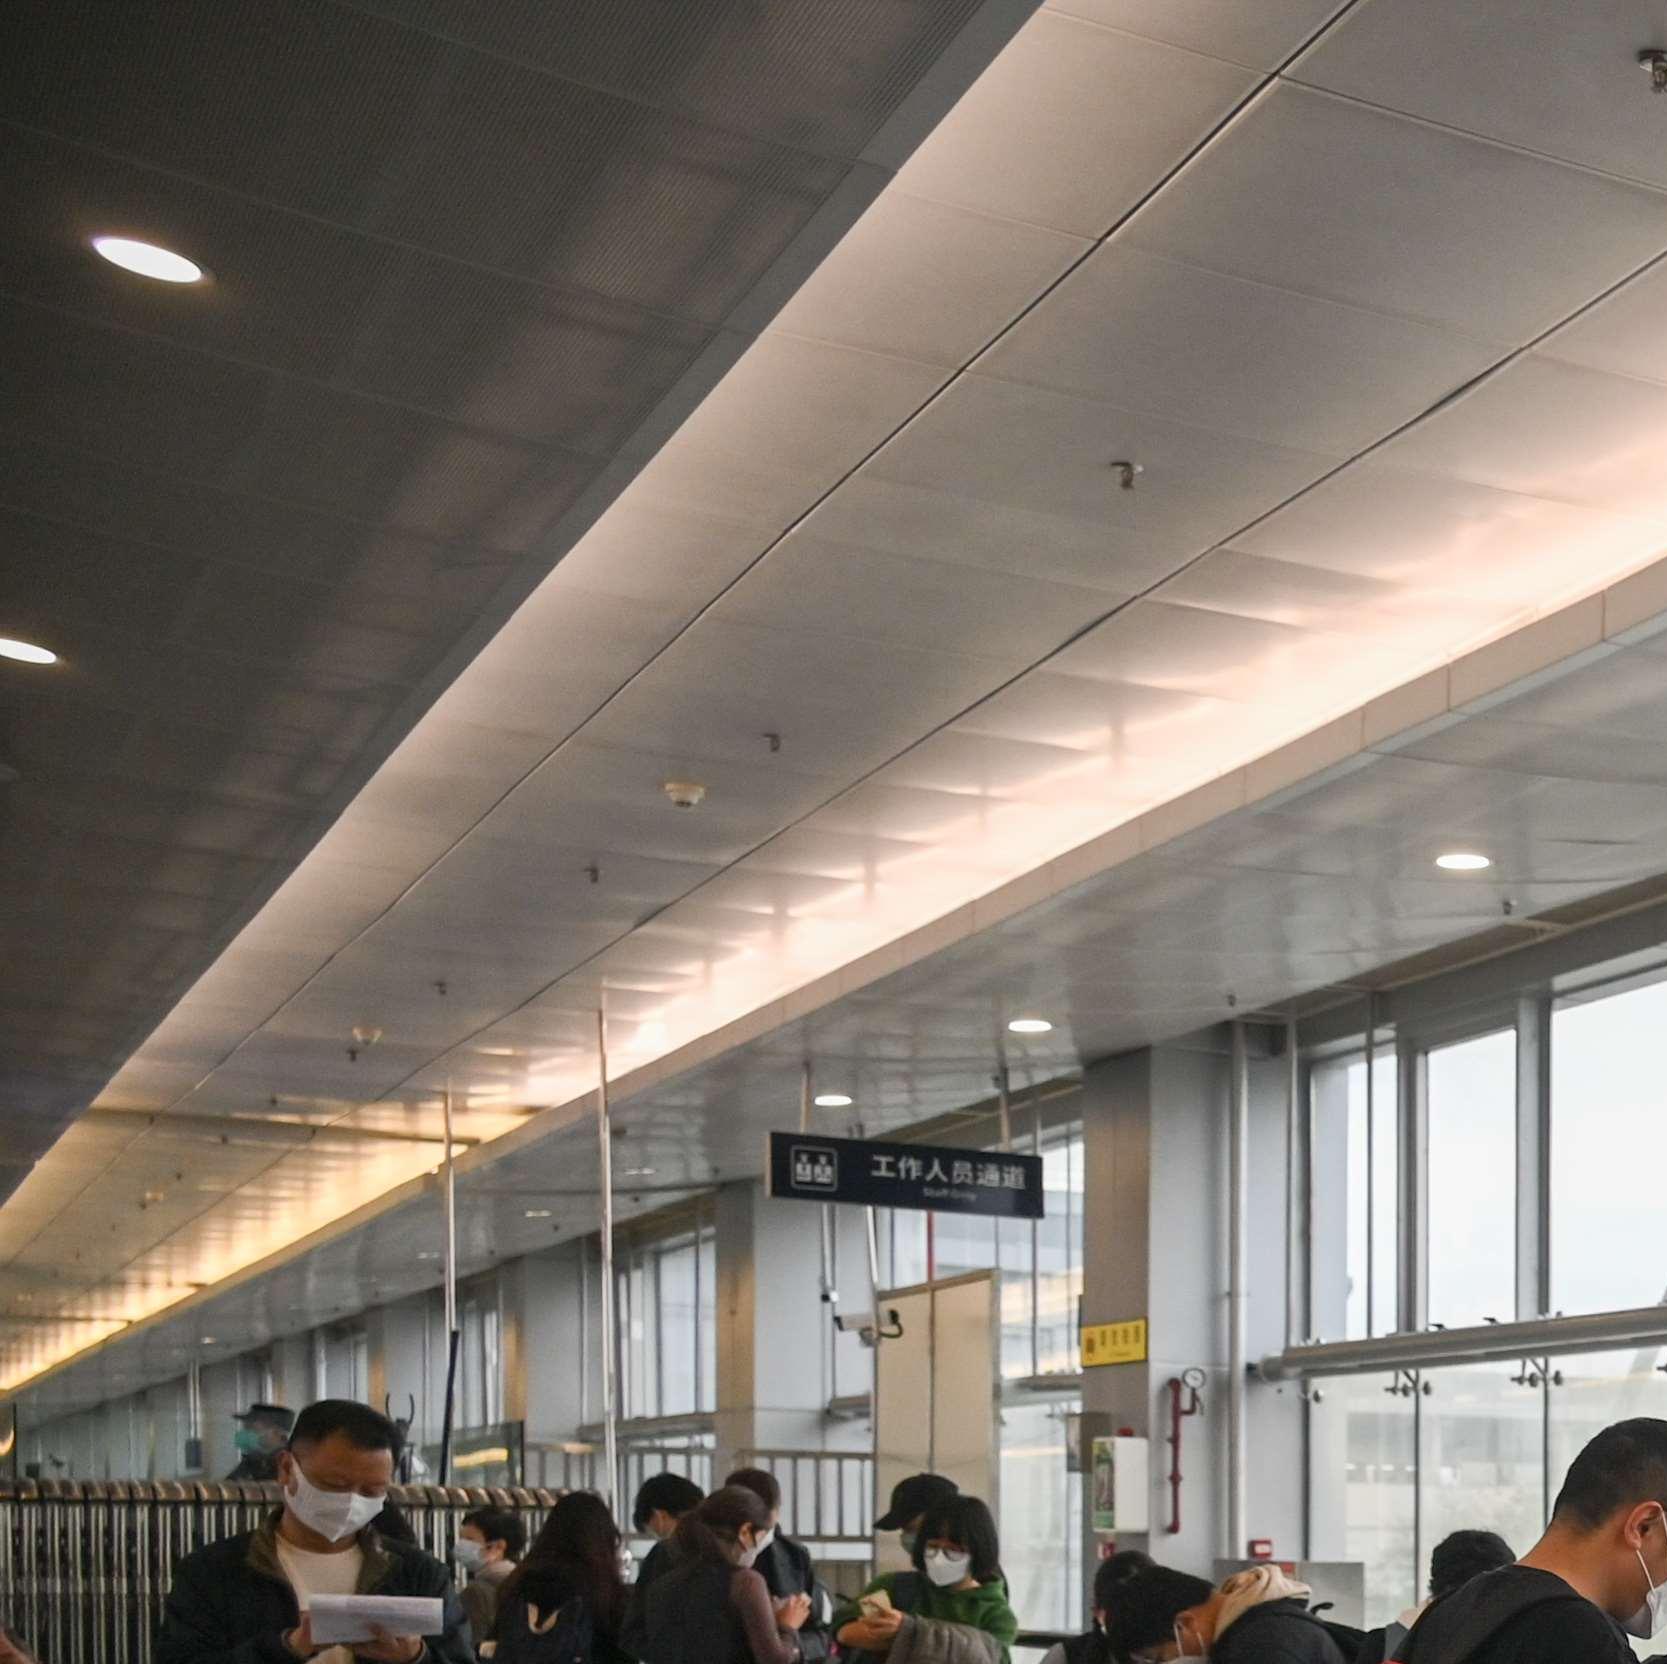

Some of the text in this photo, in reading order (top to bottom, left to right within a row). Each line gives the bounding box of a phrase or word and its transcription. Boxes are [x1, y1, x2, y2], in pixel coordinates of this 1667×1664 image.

[871, 1154, 1026, 1190] 工作人员通道
